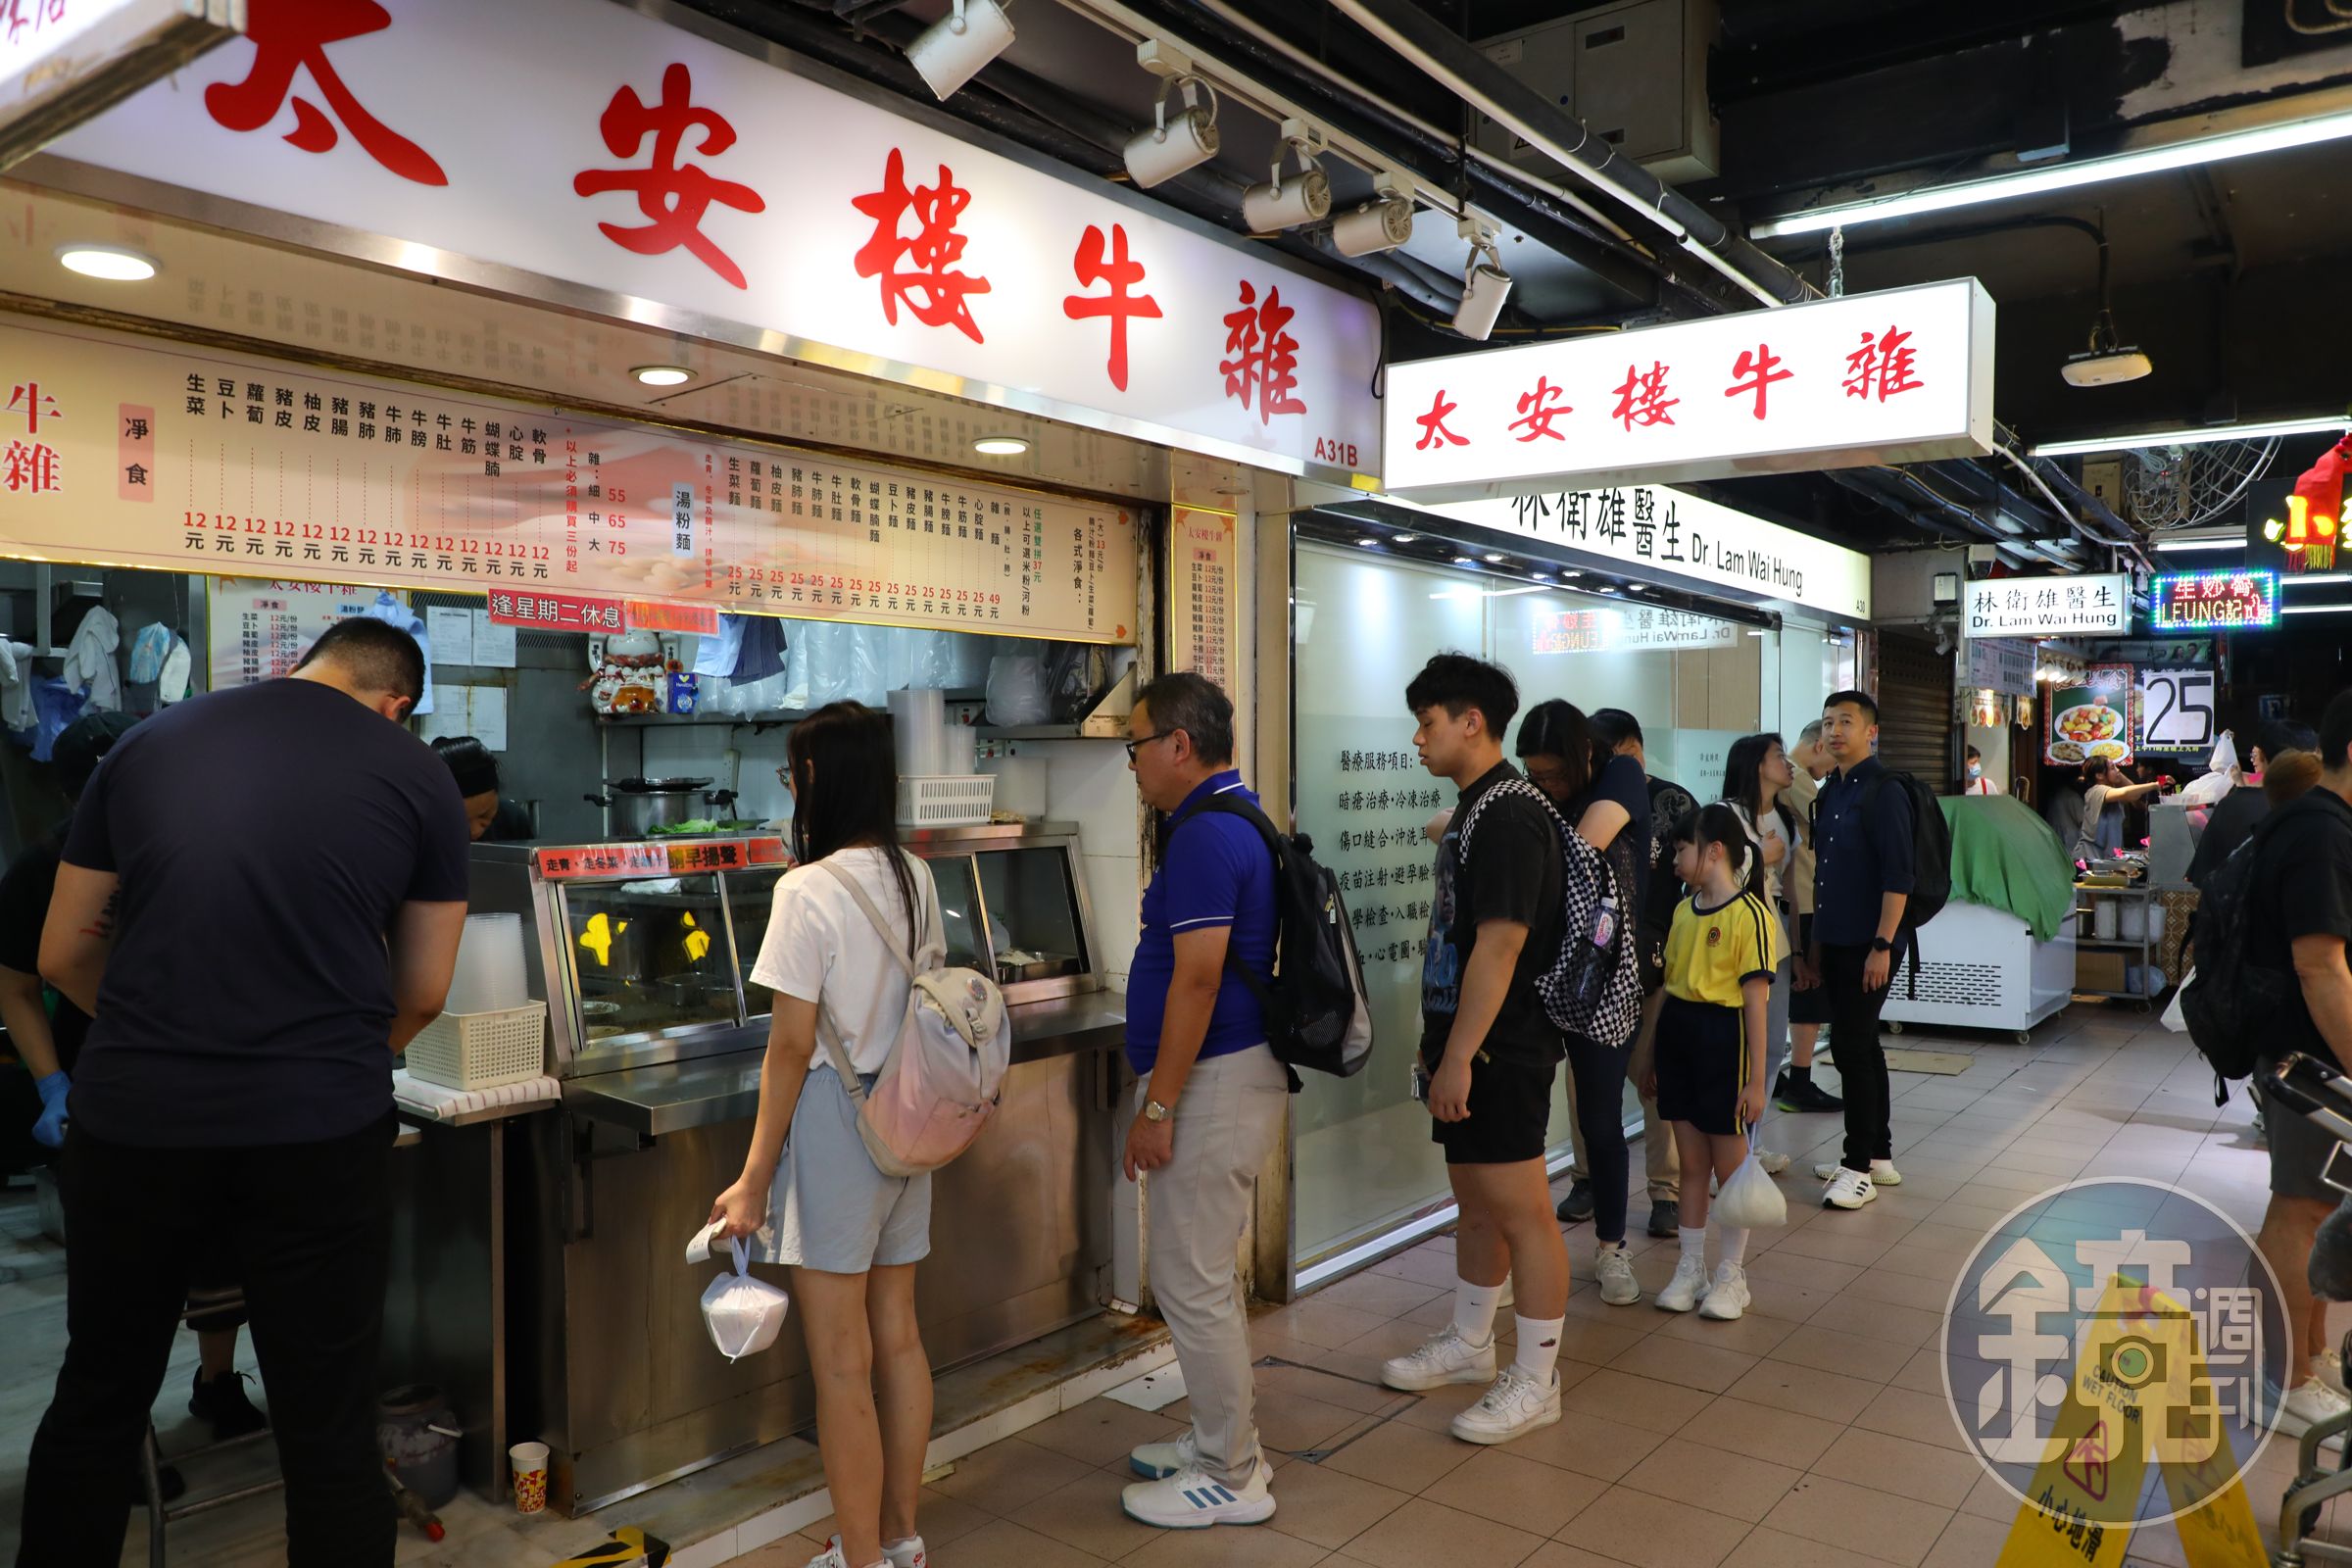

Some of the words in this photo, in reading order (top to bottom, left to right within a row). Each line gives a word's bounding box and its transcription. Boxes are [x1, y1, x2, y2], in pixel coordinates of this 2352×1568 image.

[204, 0, 1307, 425] 太安樓牛雜
[186, 373, 206, 416] 生菜
[217, 378, 235, 419] 豆卜
[246, 382, 265, 424] 蘿蔔
[274, 387, 293, 429] 豬皮
[1415, 325, 1924, 452] 太安樓牛雜
[303, 392, 321, 433] 柚皮
[331, 397, 349, 437] 豬腸
[358, 401, 375, 440] 豬肺
[385, 406, 402, 444] 牛肺
[411, 410, 427, 448] 牛膀
[436, 414, 452, 451] 牛肚
[1, 382, 63, 494] 牛雜
[461, 417, 476, 455] 牛筋
[484, 421, 500, 477] 蝴蝶腩
[532, 428, 547, 465] 軟骨
[1314, 435, 1359, 468] A31B
[608, 488, 625, 503] 55
[728, 457, 741, 506] 生菜麵
[750, 461, 761, 510] 蘿蔔麵
[770, 464, 782, 514] 柚皮麵
[791, 467, 803, 515] 豬肺麵
[811, 470, 822, 518] 牛肺麵
[831, 474, 842, 521] 牛肚麵
[850, 477, 861, 523] 軟骨麵
[589, 512, 600, 524] 中
[608, 514, 625, 528] 65
[675, 490, 691, 551] 湯粉麵
[869, 481, 880, 543] 蝴蝶腩麵
[888, 483, 899, 528] 豆卜麵
[906, 486, 916, 531] 豬皮麵
[923, 489, 934, 533] 豬腸麵
[941, 492, 951, 536] 牛膀麵
[957, 495, 967, 539] 牛筋麵
[183, 512, 207, 551] 12元
[215, 514, 237, 553] 12元
[244, 517, 266, 556] 12元
[273, 520, 295, 559] 12元
[302, 523, 323, 561] 12元
[329, 526, 351, 563] 12元
[357, 528, 377, 564] 12元
[383, 531, 403, 566] 12元
[410, 534, 429, 568] 12元
[588, 538, 600, 552] 大
[609, 540, 625, 555] 75
[435, 537, 454, 571] 12元
[460, 539, 478, 573] 12元
[484, 541, 503, 575] 12元
[509, 544, 526, 576] 12元
[532, 546, 550, 579] 12元
[1692, 532, 1712, 566] Dr.
[1716, 549, 1745, 576] Lam
[1748, 551, 1770, 581] Wai
[1773, 558, 1803, 597] Hung
[491, 593, 621, 628] 逢星期二休息
[1973, 585, 2117, 613] 林衛雄醫生
[1973, 615, 1993, 628] Dr.
[1999, 615, 2033, 627] Lam
[2038, 613, 2067, 625] Wai
[2073, 612, 2117, 626] Hung
[2145, 676, 2214, 746] 25
[2082, 1375, 2103, 1398] WET
[2106, 1390, 2140, 1425] FLOOR
[2092, 1364, 2139, 1404] CAUTION
[2037, 1485, 2104, 1564] 小心地滑
